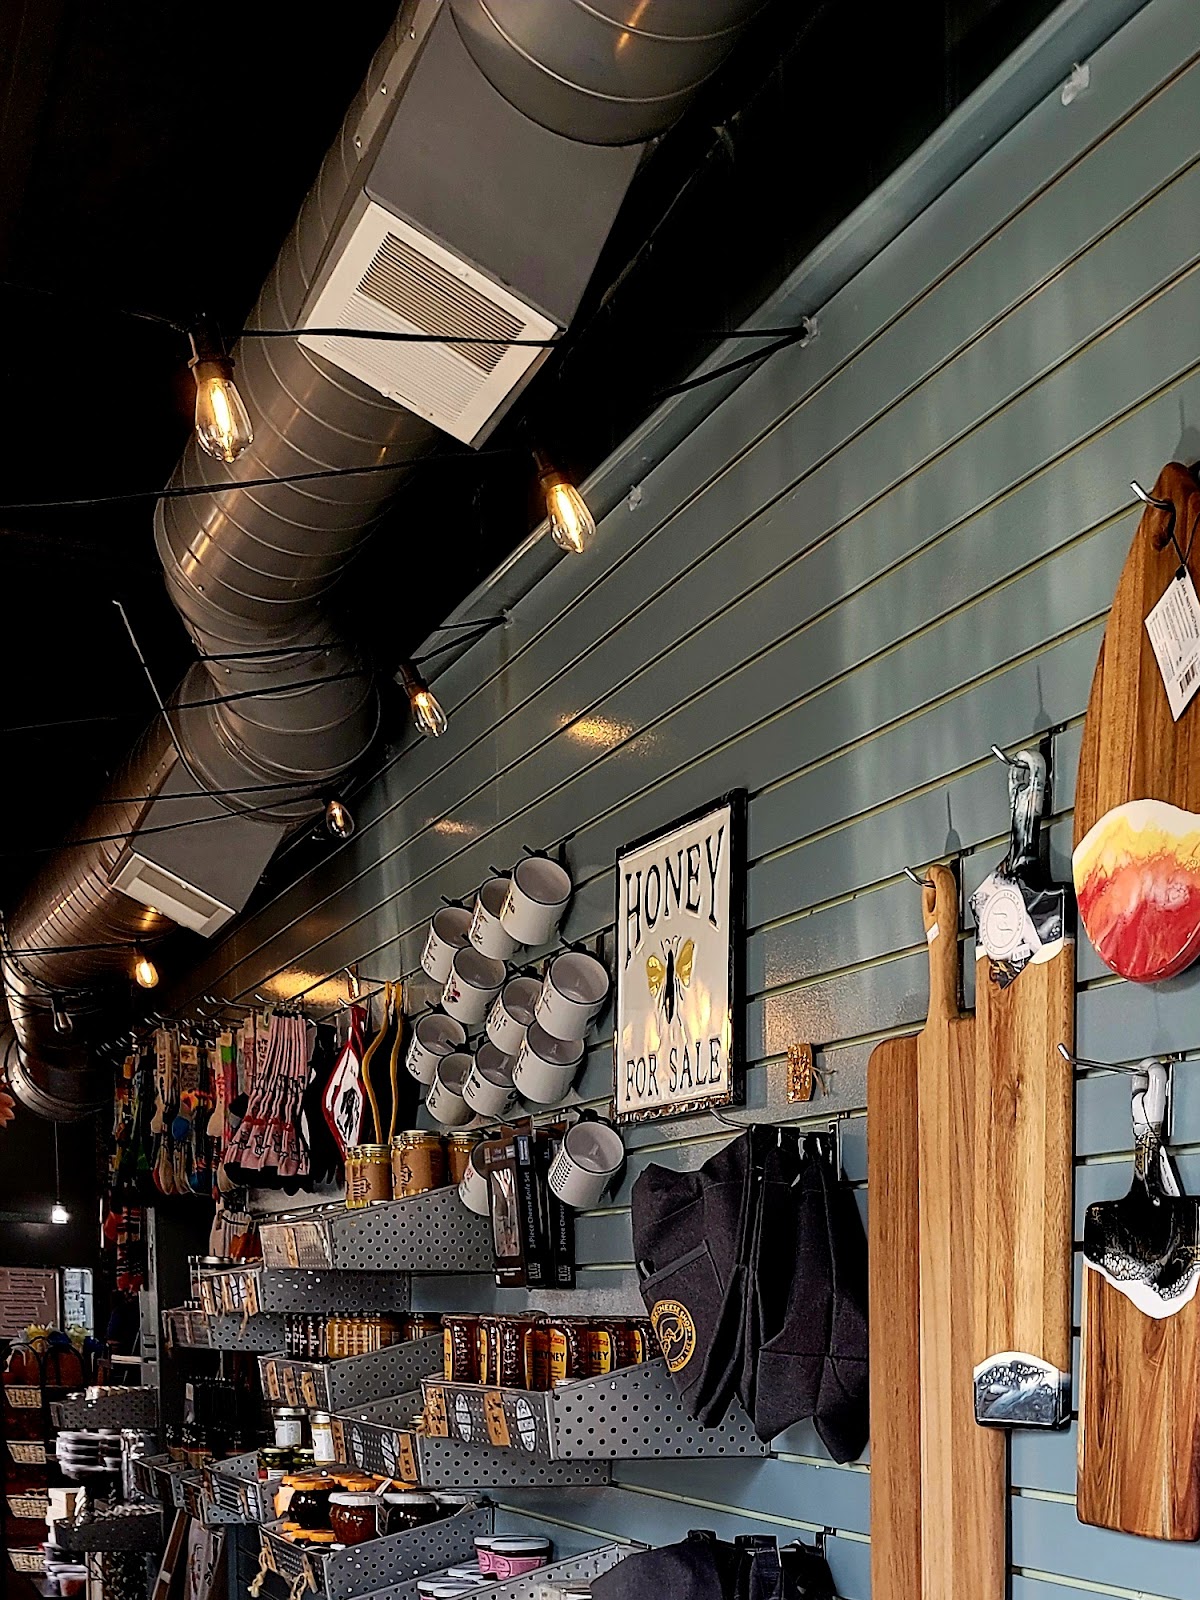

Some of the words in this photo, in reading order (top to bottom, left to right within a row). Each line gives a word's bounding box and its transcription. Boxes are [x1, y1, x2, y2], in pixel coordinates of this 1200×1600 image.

[624, 825, 727, 970] HONEY
[625, 1051, 659, 1102] FOR
[669, 1037, 722, 1093] SALE
[525, 1200, 534, 1223] Cheese
